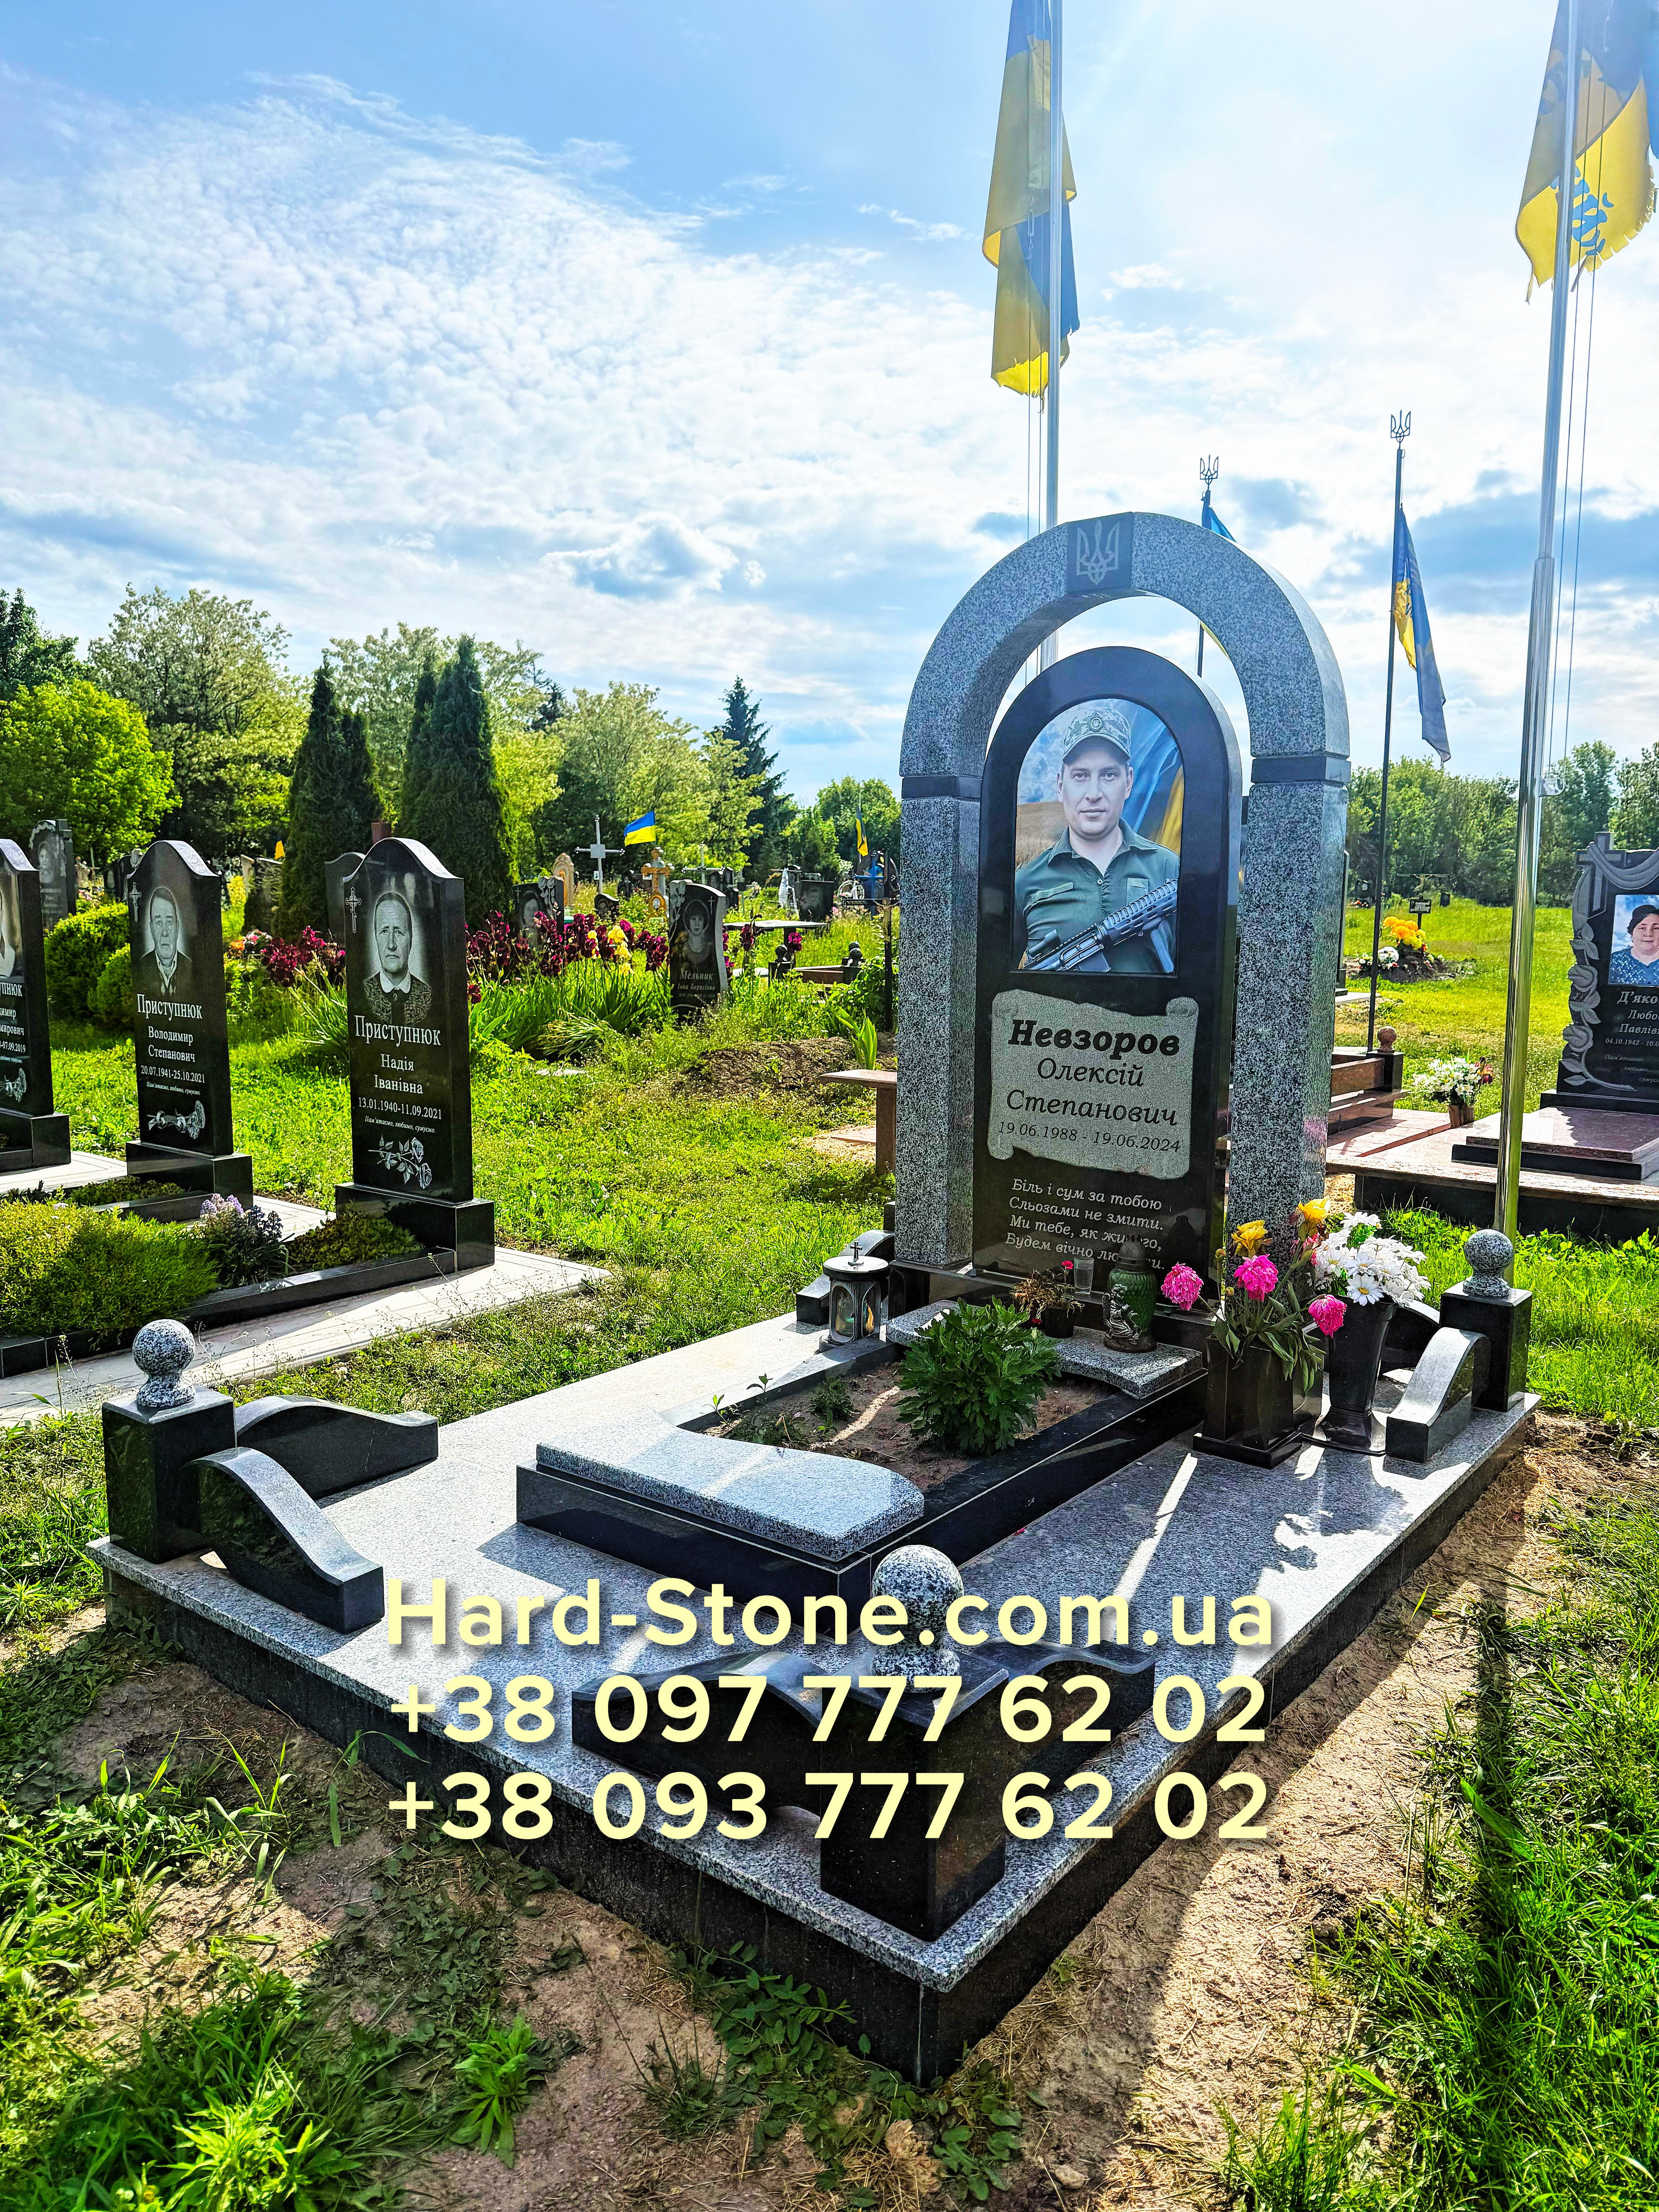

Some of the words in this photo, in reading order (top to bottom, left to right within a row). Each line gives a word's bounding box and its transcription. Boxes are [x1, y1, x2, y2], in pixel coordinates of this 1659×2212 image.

[137, 994, 203, 1021] Приступнюк
[1617, 991, 1659, 1005] Д'яко
[1628, 1010, 1659, 1020] Любо
[148, 1026, 193, 1046] Володимир
[354, 1015, 441, 1047] Приступнюк
[1008, 1019, 1180, 1060] Невзоров
[148, 1045, 195, 1062] Степанович
[380, 1054, 414, 1072] Надія
[141, 1065, 205, 1083] 20.07.1941-25.10.2021
[374, 1074, 423, 1094] Іванівна
[1037, 1058, 1144, 1086] Олексій
[359, 1097, 442, 1120] 13.01.1940-11.09.2021
[1007, 1089, 1177, 1126] Степанович
[999, 1121, 1077, 1141] 19.06.1988
[1094, 1132, 1180, 1152] 19.06.2024
[1012, 1178, 1043, 1194] Біль
[1048, 1183, 1052, 1195] і
[1056, 1187, 1084, 1200] сум
[1088, 1192, 1105, 1202] за
[1111, 1194, 1162, 1210] тобою
[1009, 1197, 1080, 1218] Сльозами
[1085, 1209, 1102, 1221] не
[1106, 1212, 1163, 1230] змити.
[1005, 1232, 1051, 1251] Будем
[1055, 1241, 1093, 1258] вічно
[1009, 1214, 1030, 1229] Ми
[1035, 1220, 1074, 1238] тебе,
[1079, 1228, 1098, 1240] як
[1102, 1231, 1161, 1252] жиго,
